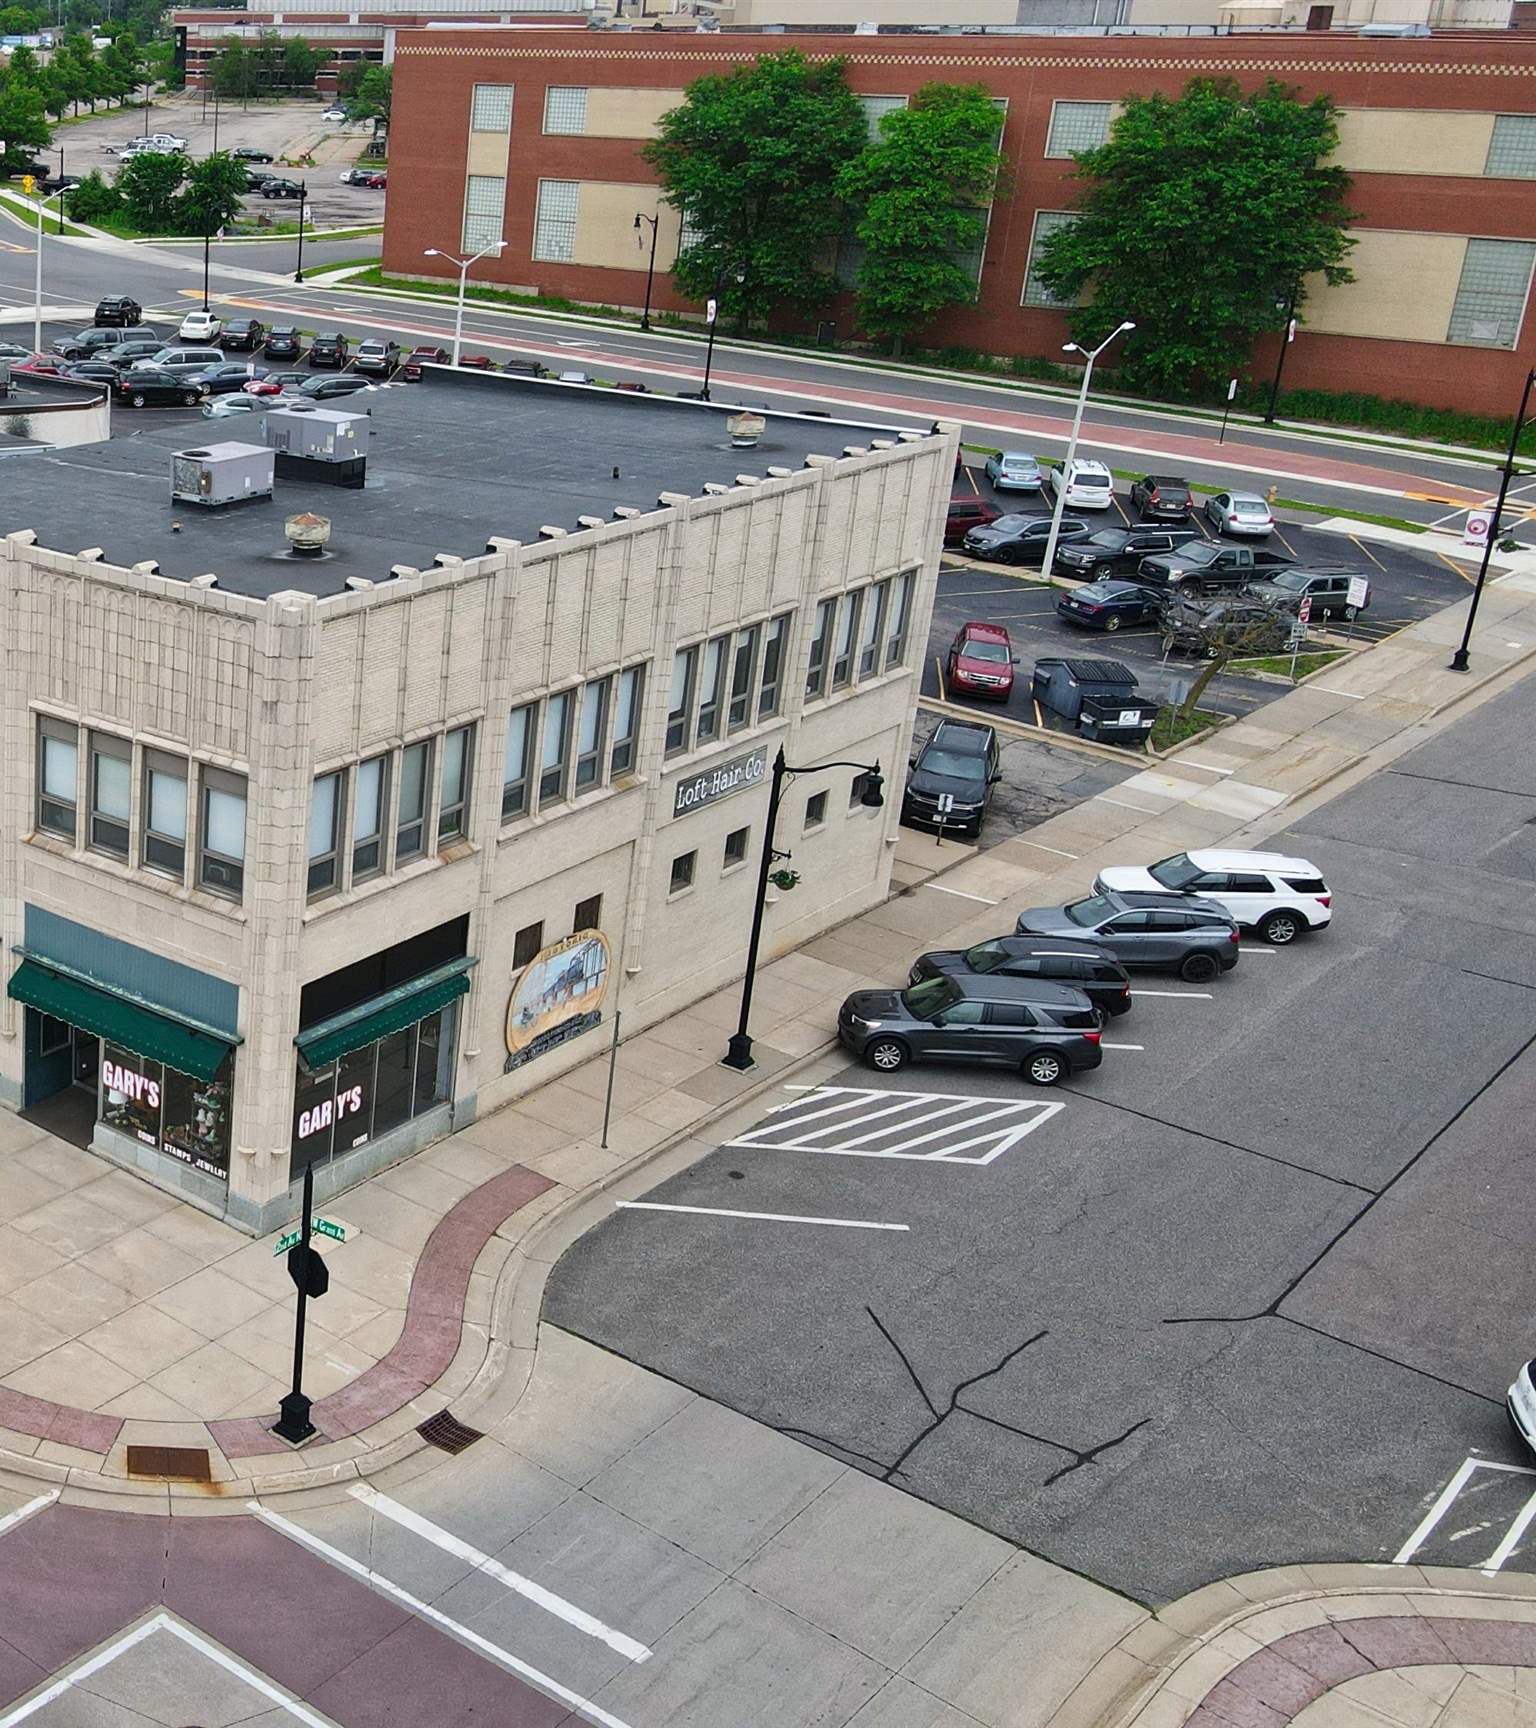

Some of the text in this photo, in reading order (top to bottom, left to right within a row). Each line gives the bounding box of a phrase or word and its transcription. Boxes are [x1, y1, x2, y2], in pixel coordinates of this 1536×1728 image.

[676, 752, 764, 810] Loft Hair Co.
[103, 1060, 160, 1108] GARY'S
[298, 1085, 362, 1140] GARY'S
[163, 1142, 192, 1163] STAMPS
